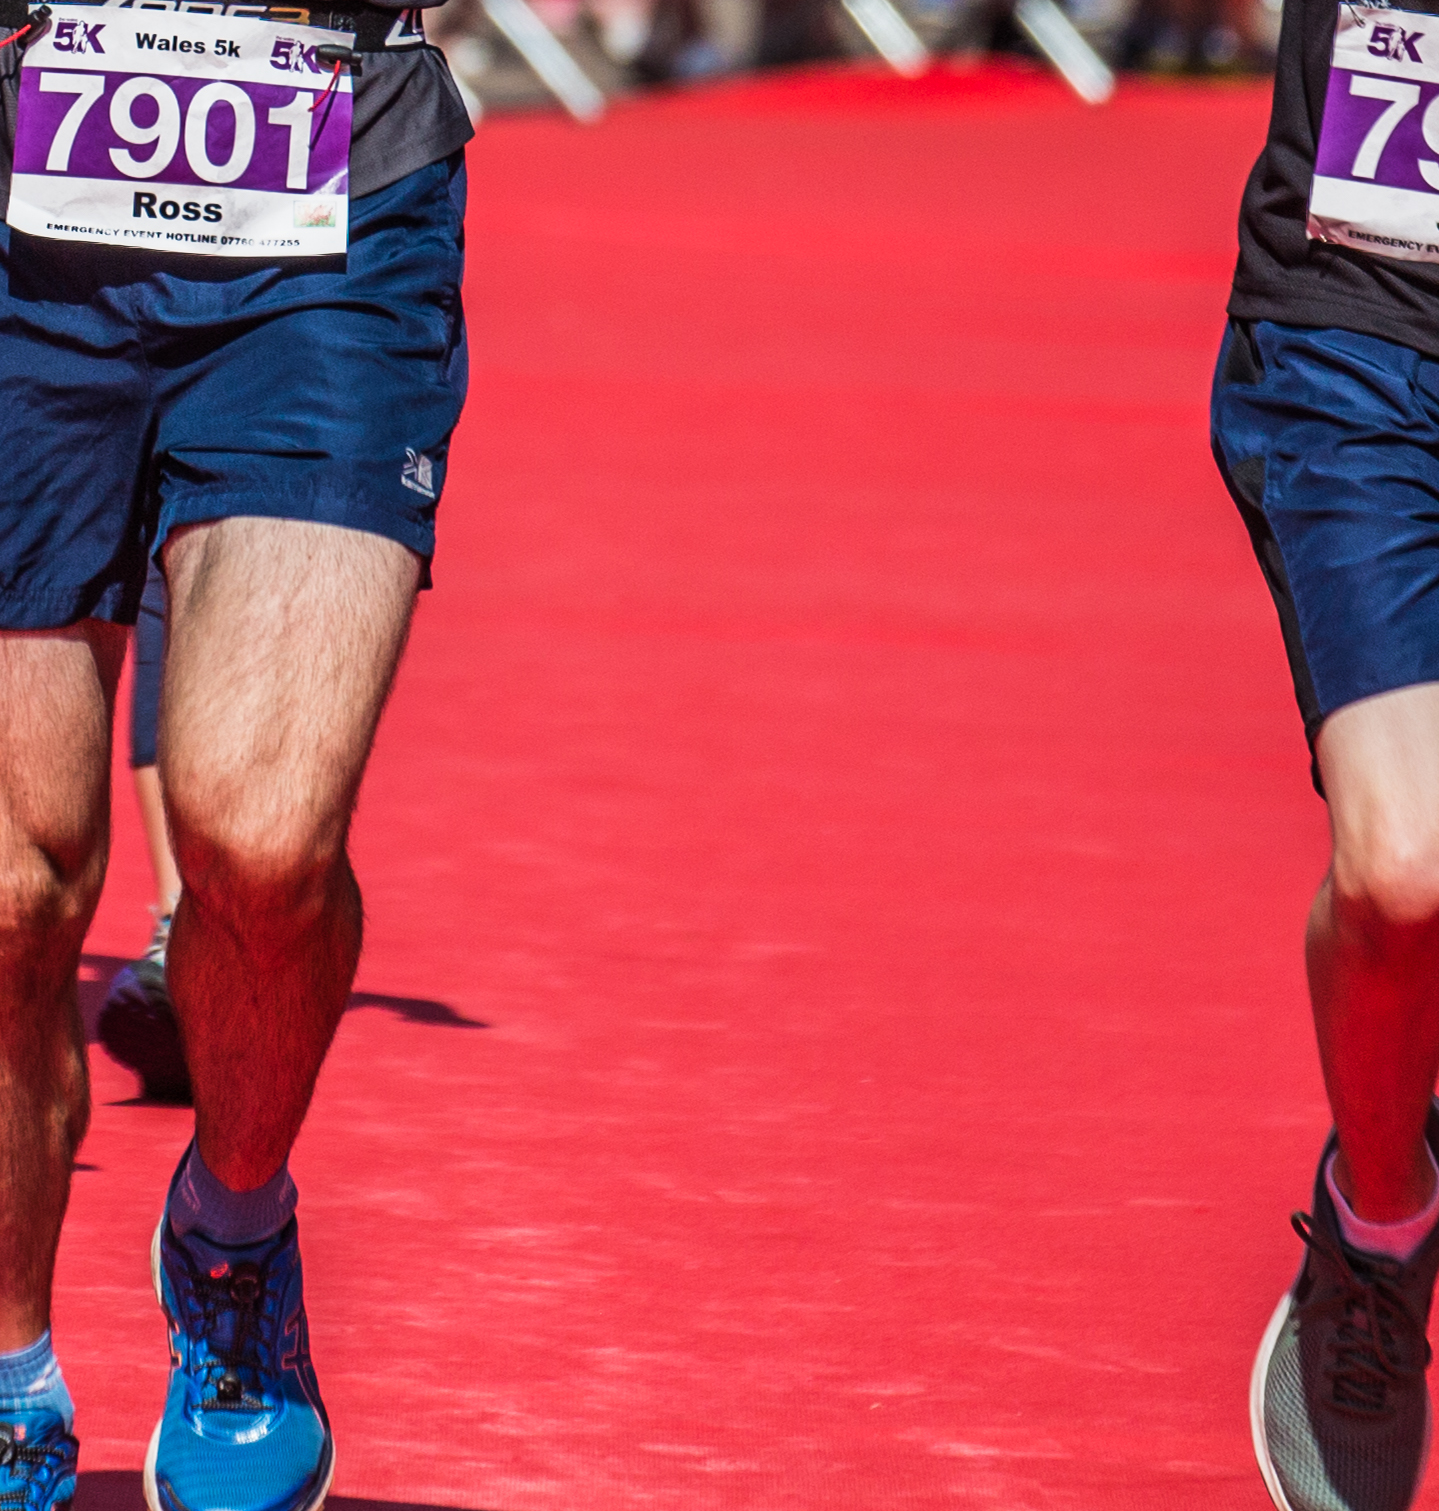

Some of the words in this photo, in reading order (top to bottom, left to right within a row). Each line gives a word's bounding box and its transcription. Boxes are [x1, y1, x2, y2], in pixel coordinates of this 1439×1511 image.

[135, 31, 207, 55] Wales
[214, 38, 241, 58] 5k
[38, 71, 315, 191] 7901
[131, 191, 223, 223] Ross
[46, 222, 121, 237] EMERGENCY
[123, 229, 163, 240] EVENT
[165, 232, 218, 245] HOTLINE
[1347, 229, 1425, 252] EMERGENCY
